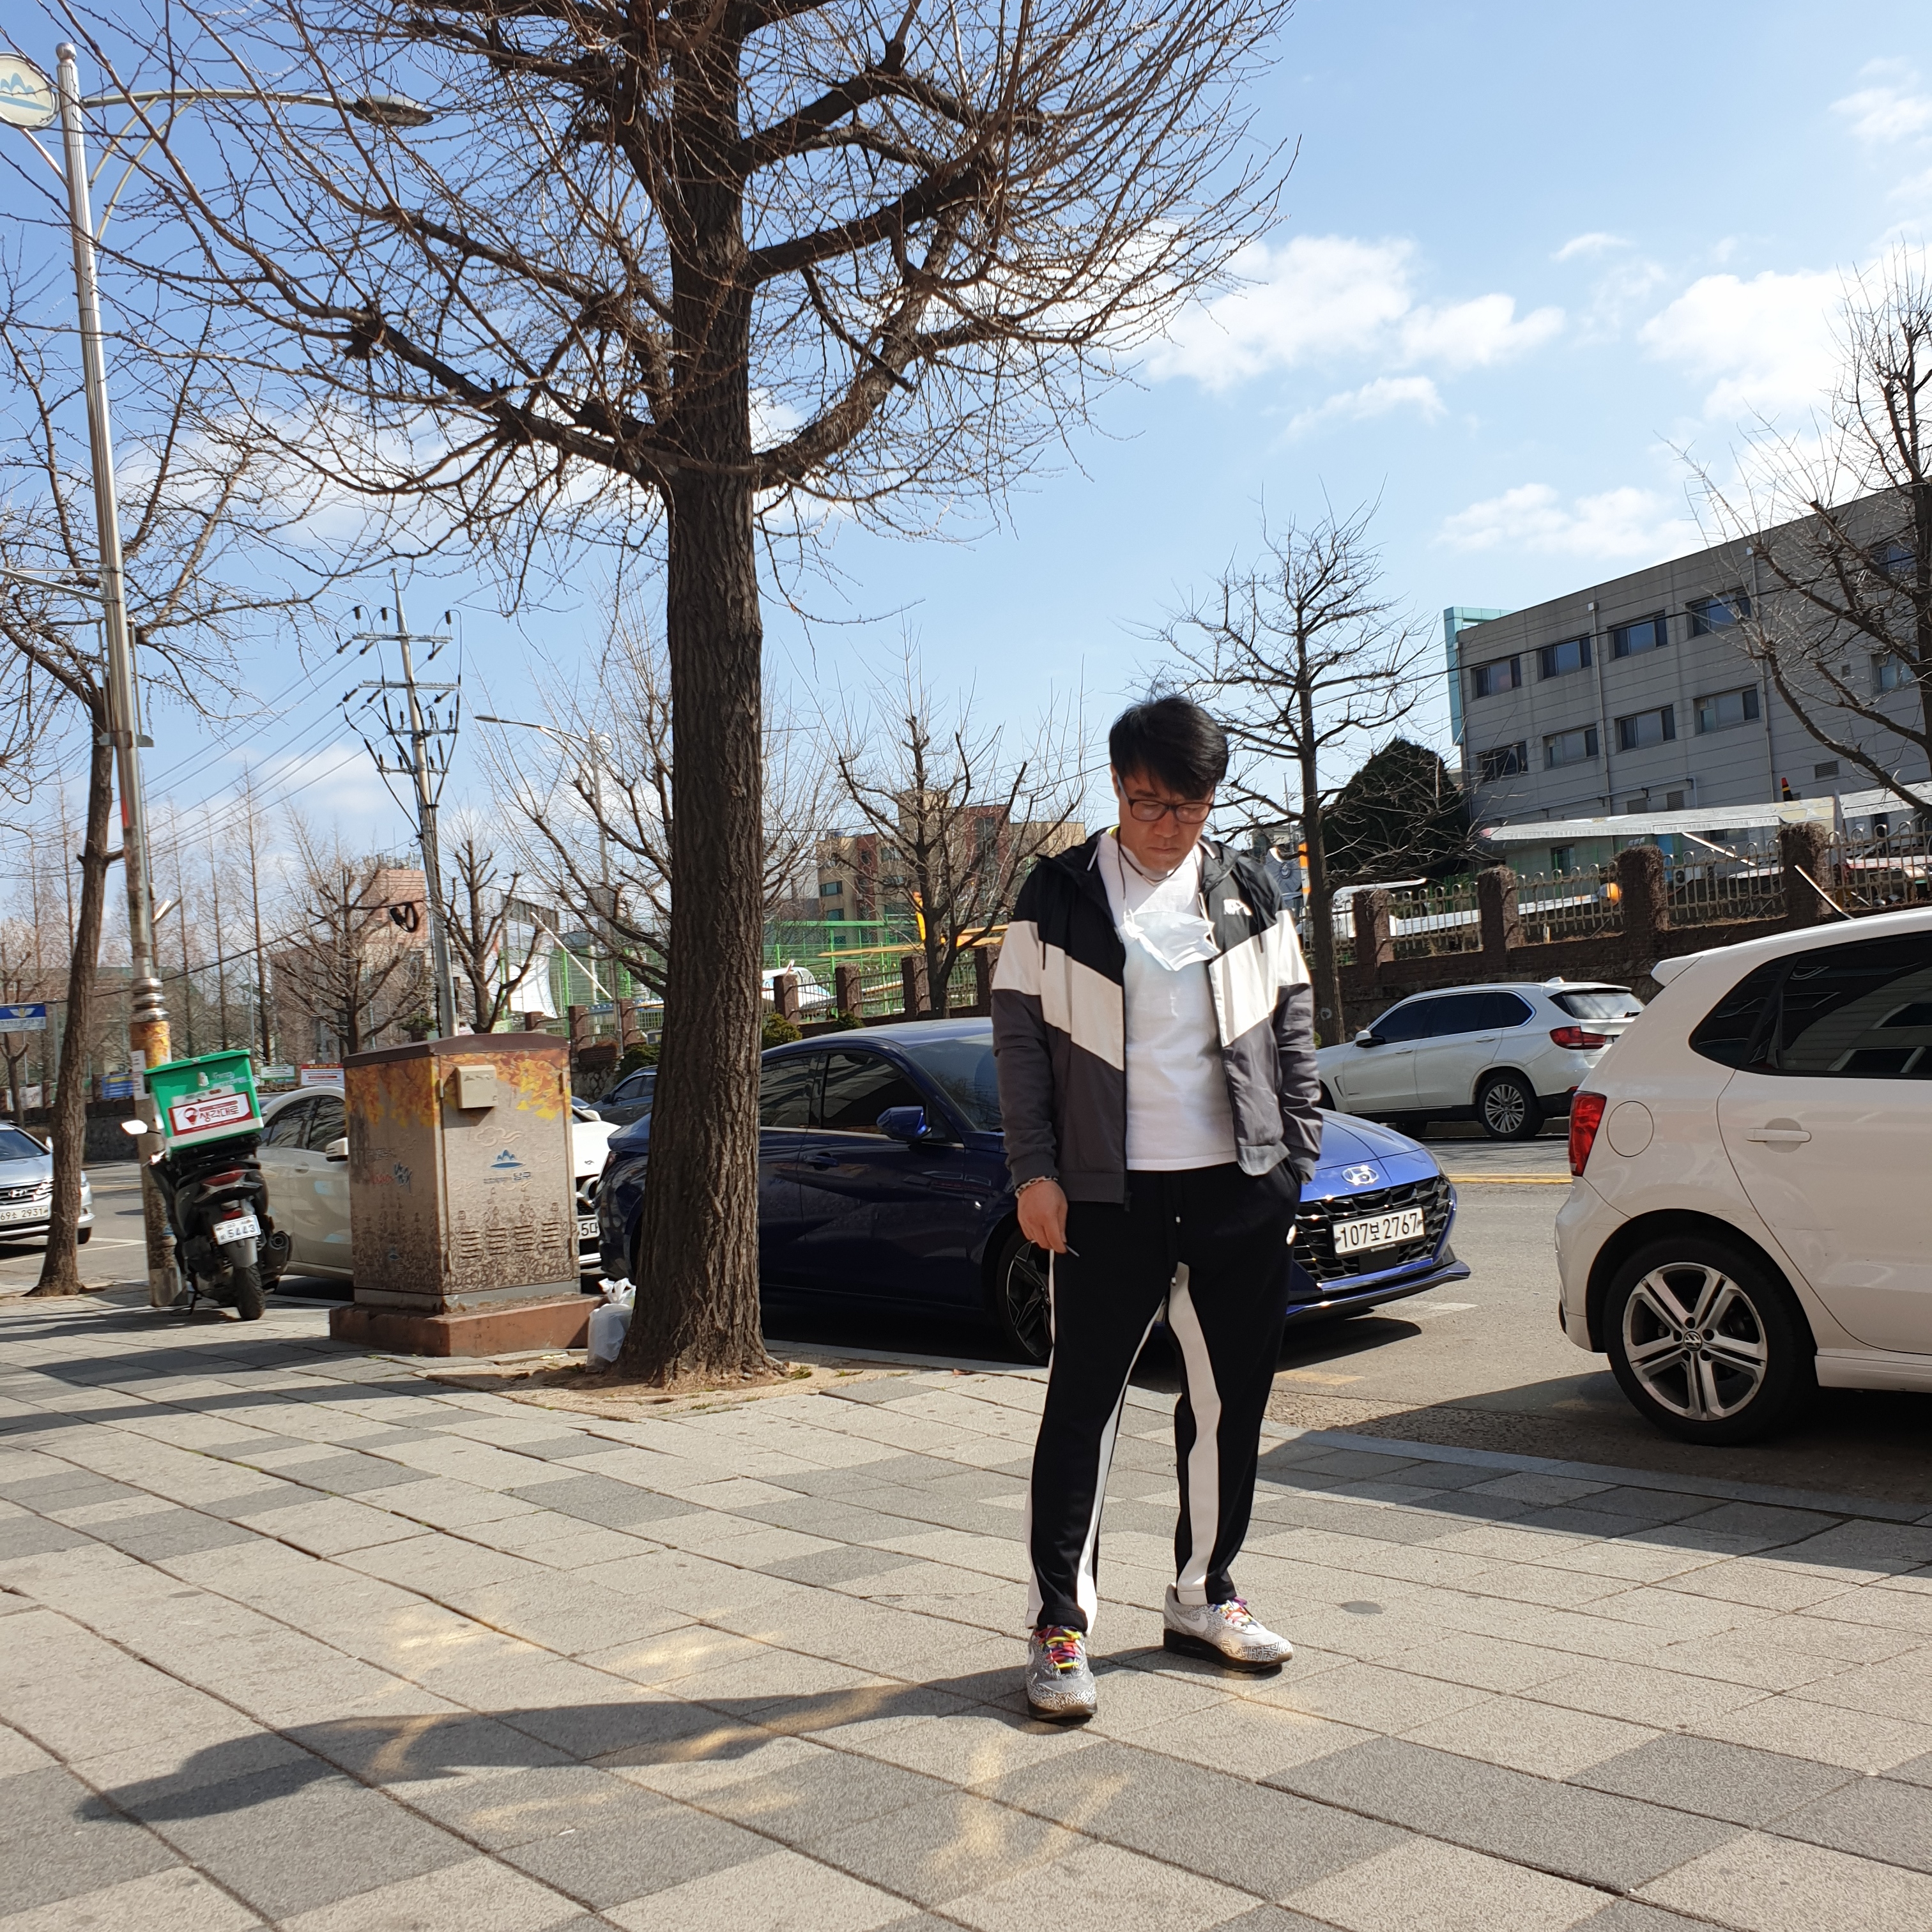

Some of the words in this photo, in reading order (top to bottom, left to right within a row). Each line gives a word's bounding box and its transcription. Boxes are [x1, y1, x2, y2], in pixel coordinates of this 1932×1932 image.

[200, 1105, 239, 1122] 생각대로
[513, 1171, 532, 1181] 남구
[0, 1212, 17, 1220] 69소
[21, 1208, 43, 1218] 2931
